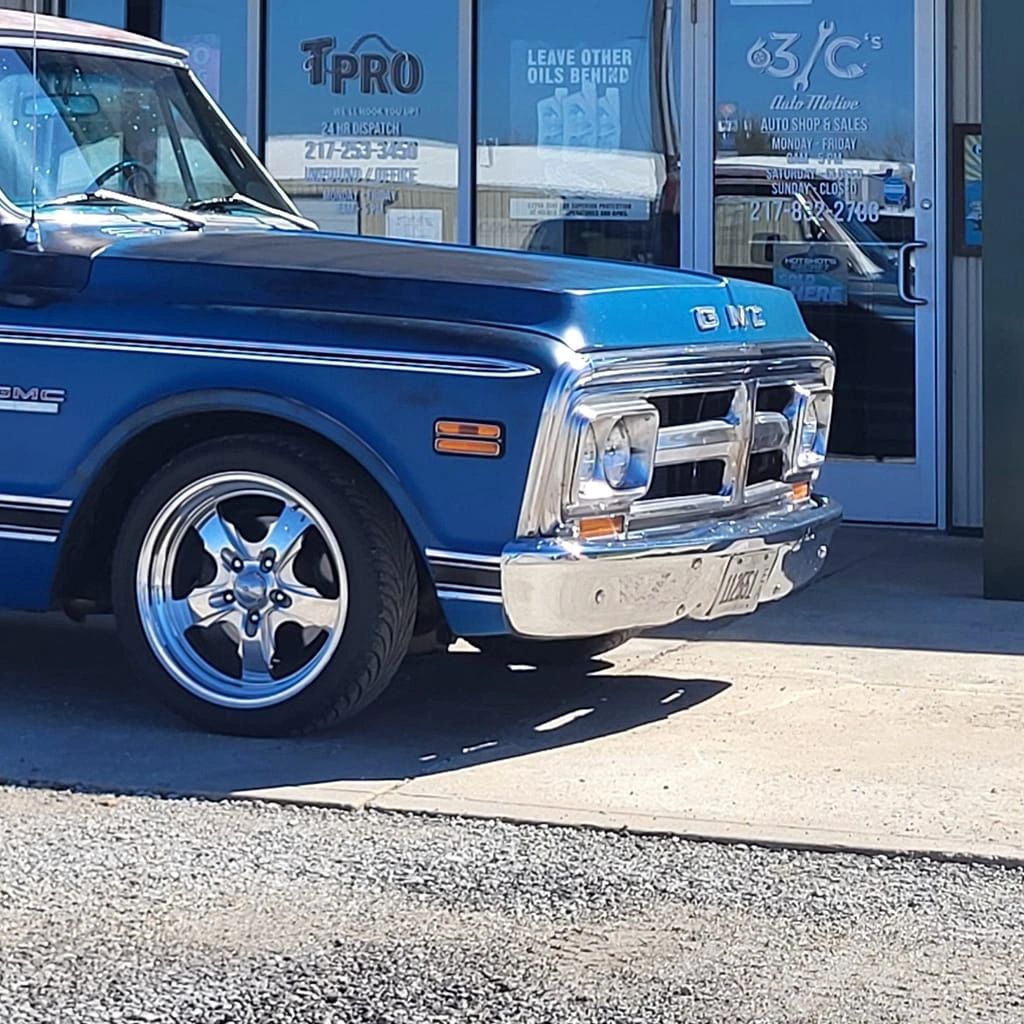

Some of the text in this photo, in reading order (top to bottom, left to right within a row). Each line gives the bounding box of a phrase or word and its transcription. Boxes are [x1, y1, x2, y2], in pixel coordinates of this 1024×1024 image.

[528, 49, 632, 66] LEAVE OTHER
[528, 67, 630, 84] OILS BEHIND
[770, 95, 860, 110] Auto Motive
[353, 122, 401, 136] DISPATCH
[761, 117, 869, 131] AUTO SHOP & SALES
[771, 137, 813, 150] MONDAY
[822, 137, 857, 150] FRIDAY
[766, 168, 815, 180] SATURDAY
[771, 183, 857, 195] SUNDAY CLOSED
